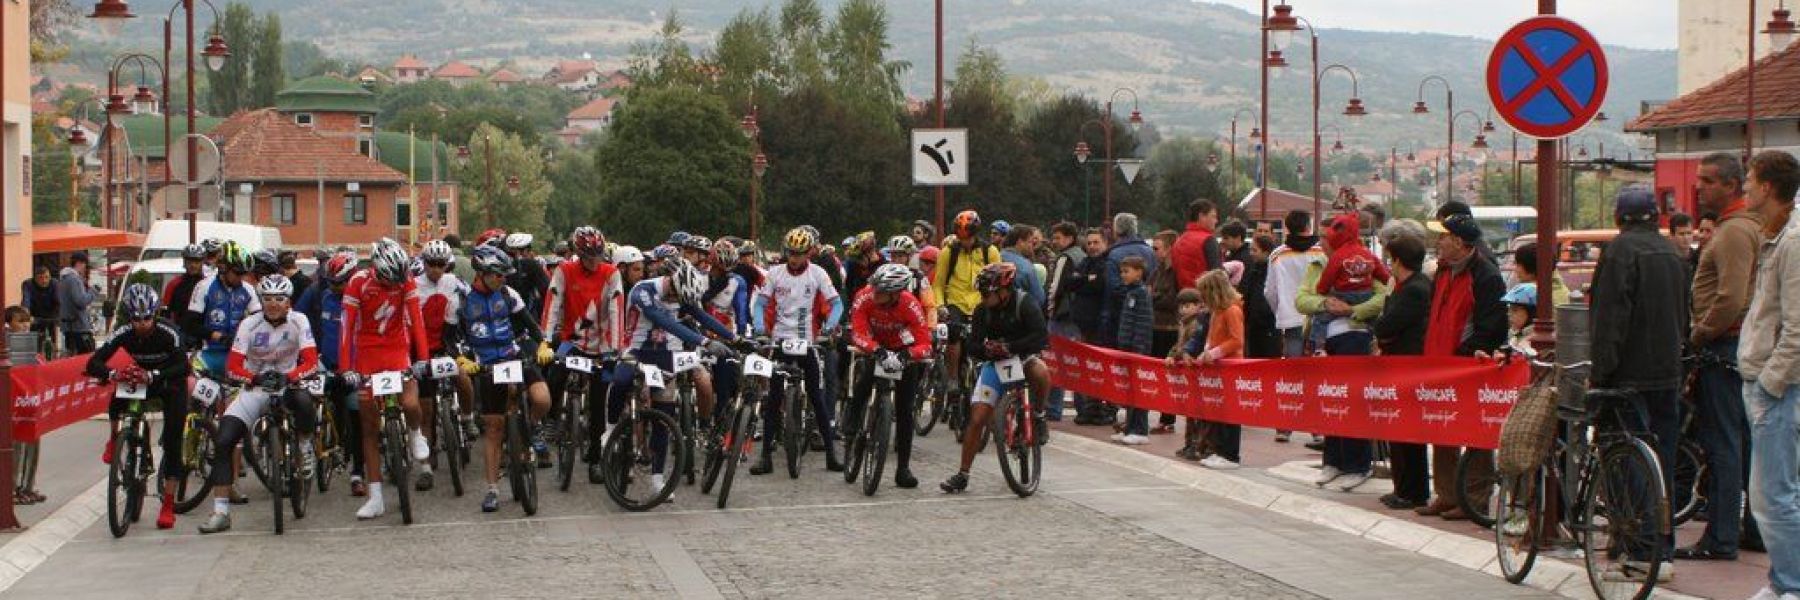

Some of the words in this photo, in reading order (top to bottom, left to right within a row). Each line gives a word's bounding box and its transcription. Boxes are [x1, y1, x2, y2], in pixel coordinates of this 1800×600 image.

[437, 362, 455, 375] 52
[753, 360, 764, 372] 6
[1003, 365, 1013, 379] 7
[503, 367, 512, 379] 1
[381, 377, 393, 390] 2
[198, 384, 214, 399] 36
